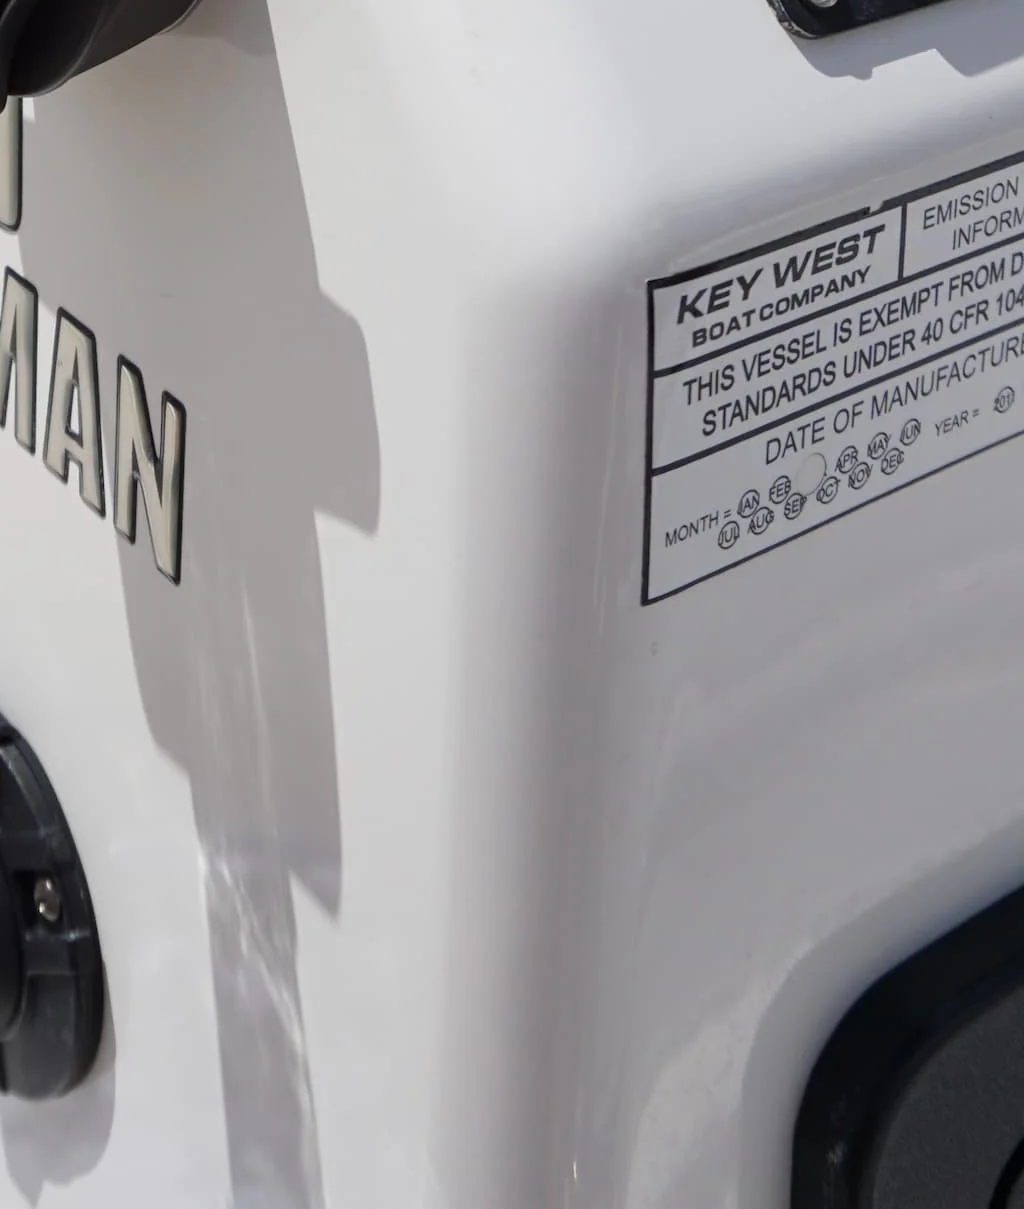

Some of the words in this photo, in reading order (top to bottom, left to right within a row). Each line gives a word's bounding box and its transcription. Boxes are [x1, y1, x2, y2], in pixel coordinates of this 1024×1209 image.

[923, 176, 1019, 230] EMISSION
[676, 268, 764, 325] KEY
[772, 223, 886, 289] WEST
[683, 363, 735, 406] THIS
[741, 329, 827, 382] VESSEL
[833, 318, 853, 347] IS
[859, 281, 944, 337] EXEMPT
[948, 257, 1006, 302] FROM
[692, 309, 756, 348] BOAT
[759, 265, 872, 322] COMPANY
[702, 360, 837, 437] STANDARDS
[842, 328, 916, 379] UNDER
[920, 317, 944, 345] 40
[949, 299, 989, 335] CFR
[765, 416, 826, 465] DATE
[833, 400, 865, 434] OF
[870, 332, 1024, 420] MANUFACTUR
[664, 510, 720, 548] MONTH
[834, 449, 859, 472] APR
[934, 409, 969, 437] YEAR
[880, 450, 905, 474] DEC
